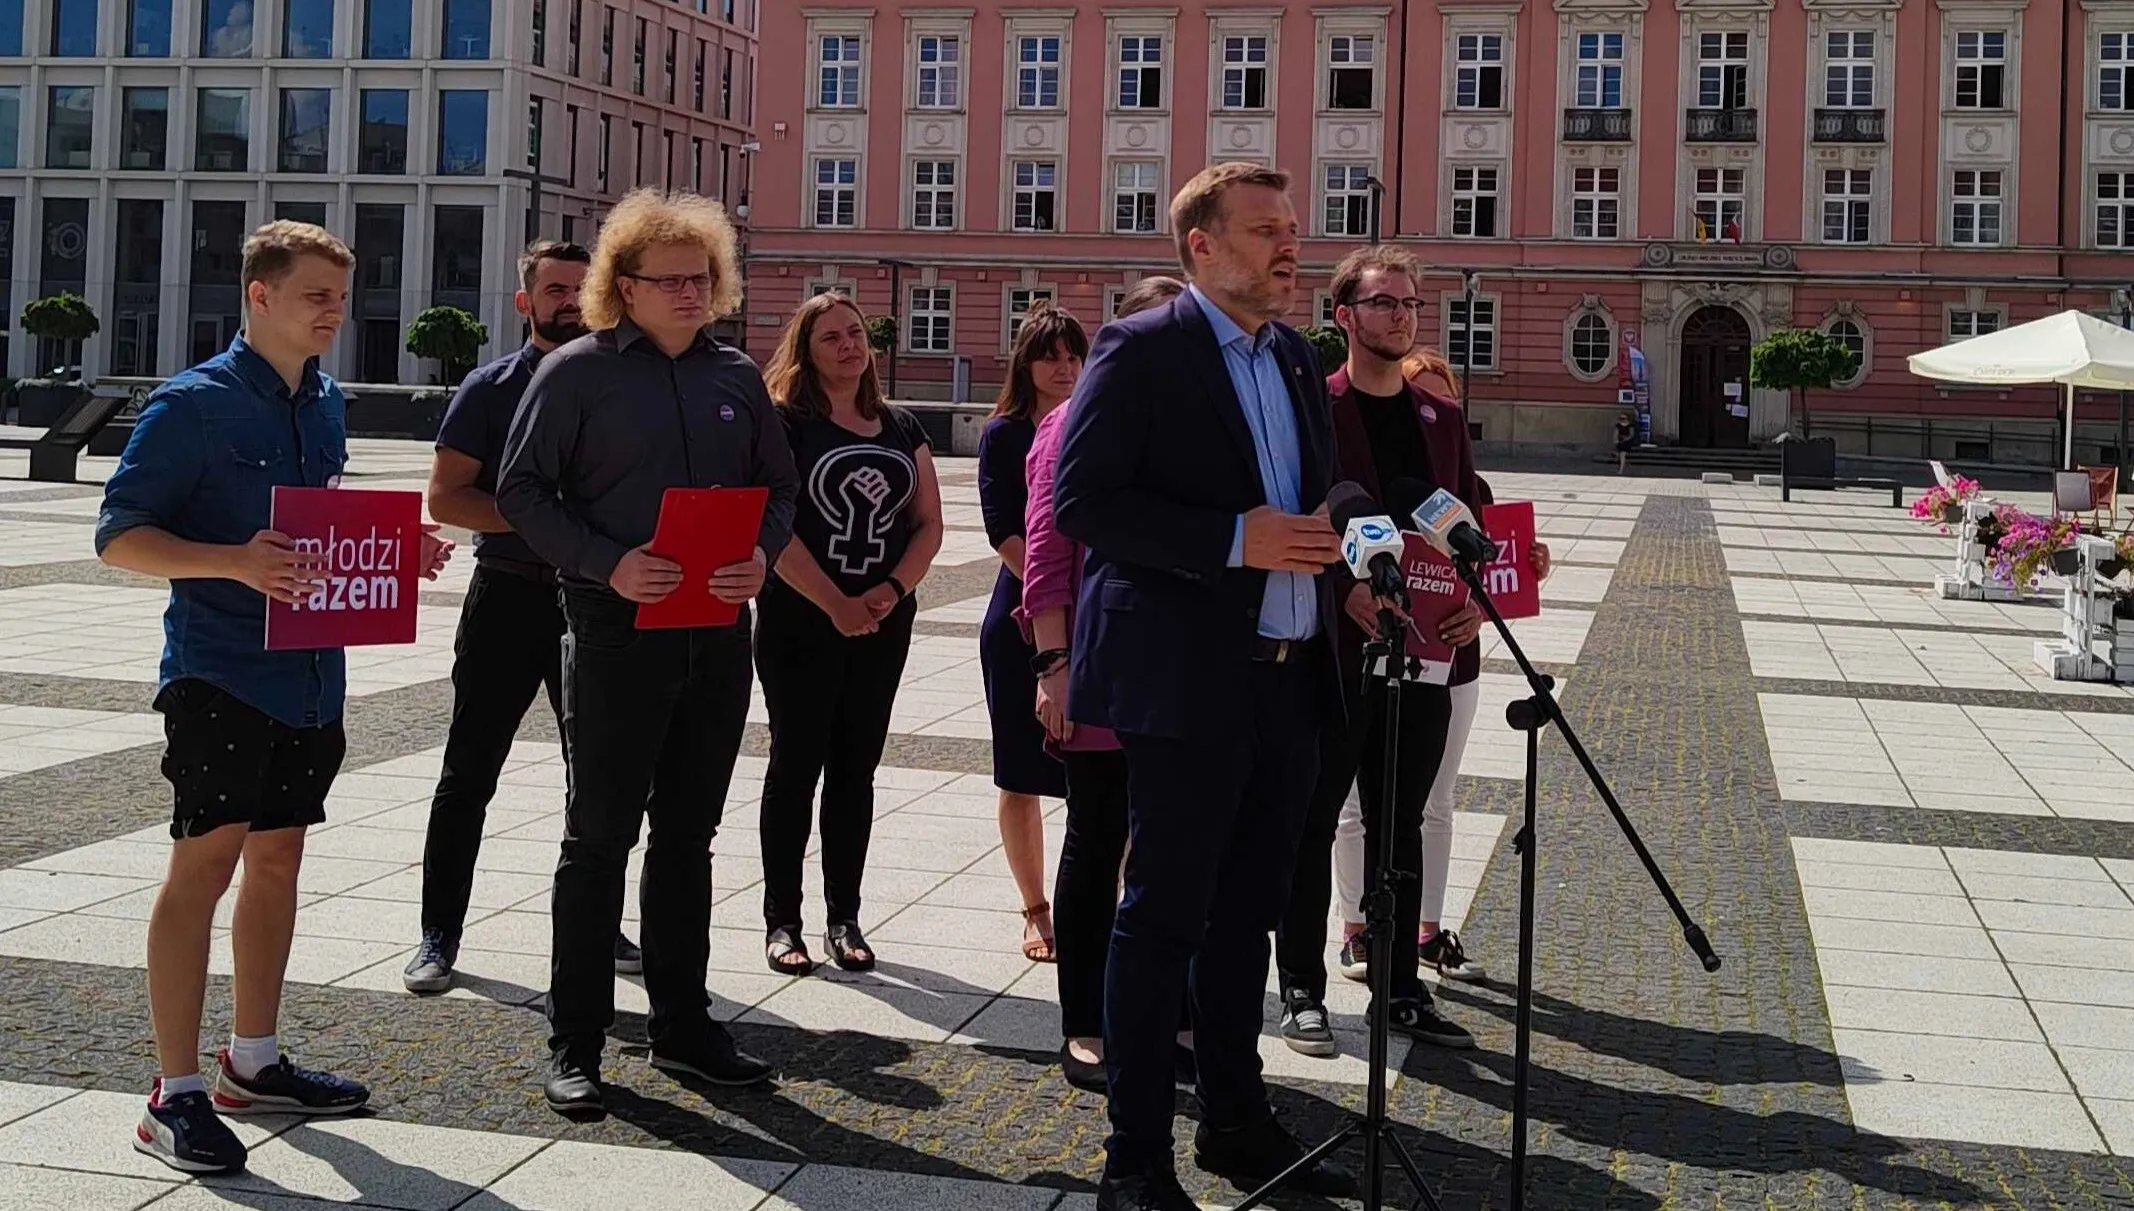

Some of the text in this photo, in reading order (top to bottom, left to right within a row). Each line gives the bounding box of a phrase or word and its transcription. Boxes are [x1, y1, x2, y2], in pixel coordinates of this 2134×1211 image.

[294, 525, 401, 571] młodzi
[1410, 560, 1457, 580] LEWICA
[1406, 575, 1455, 595] razem
